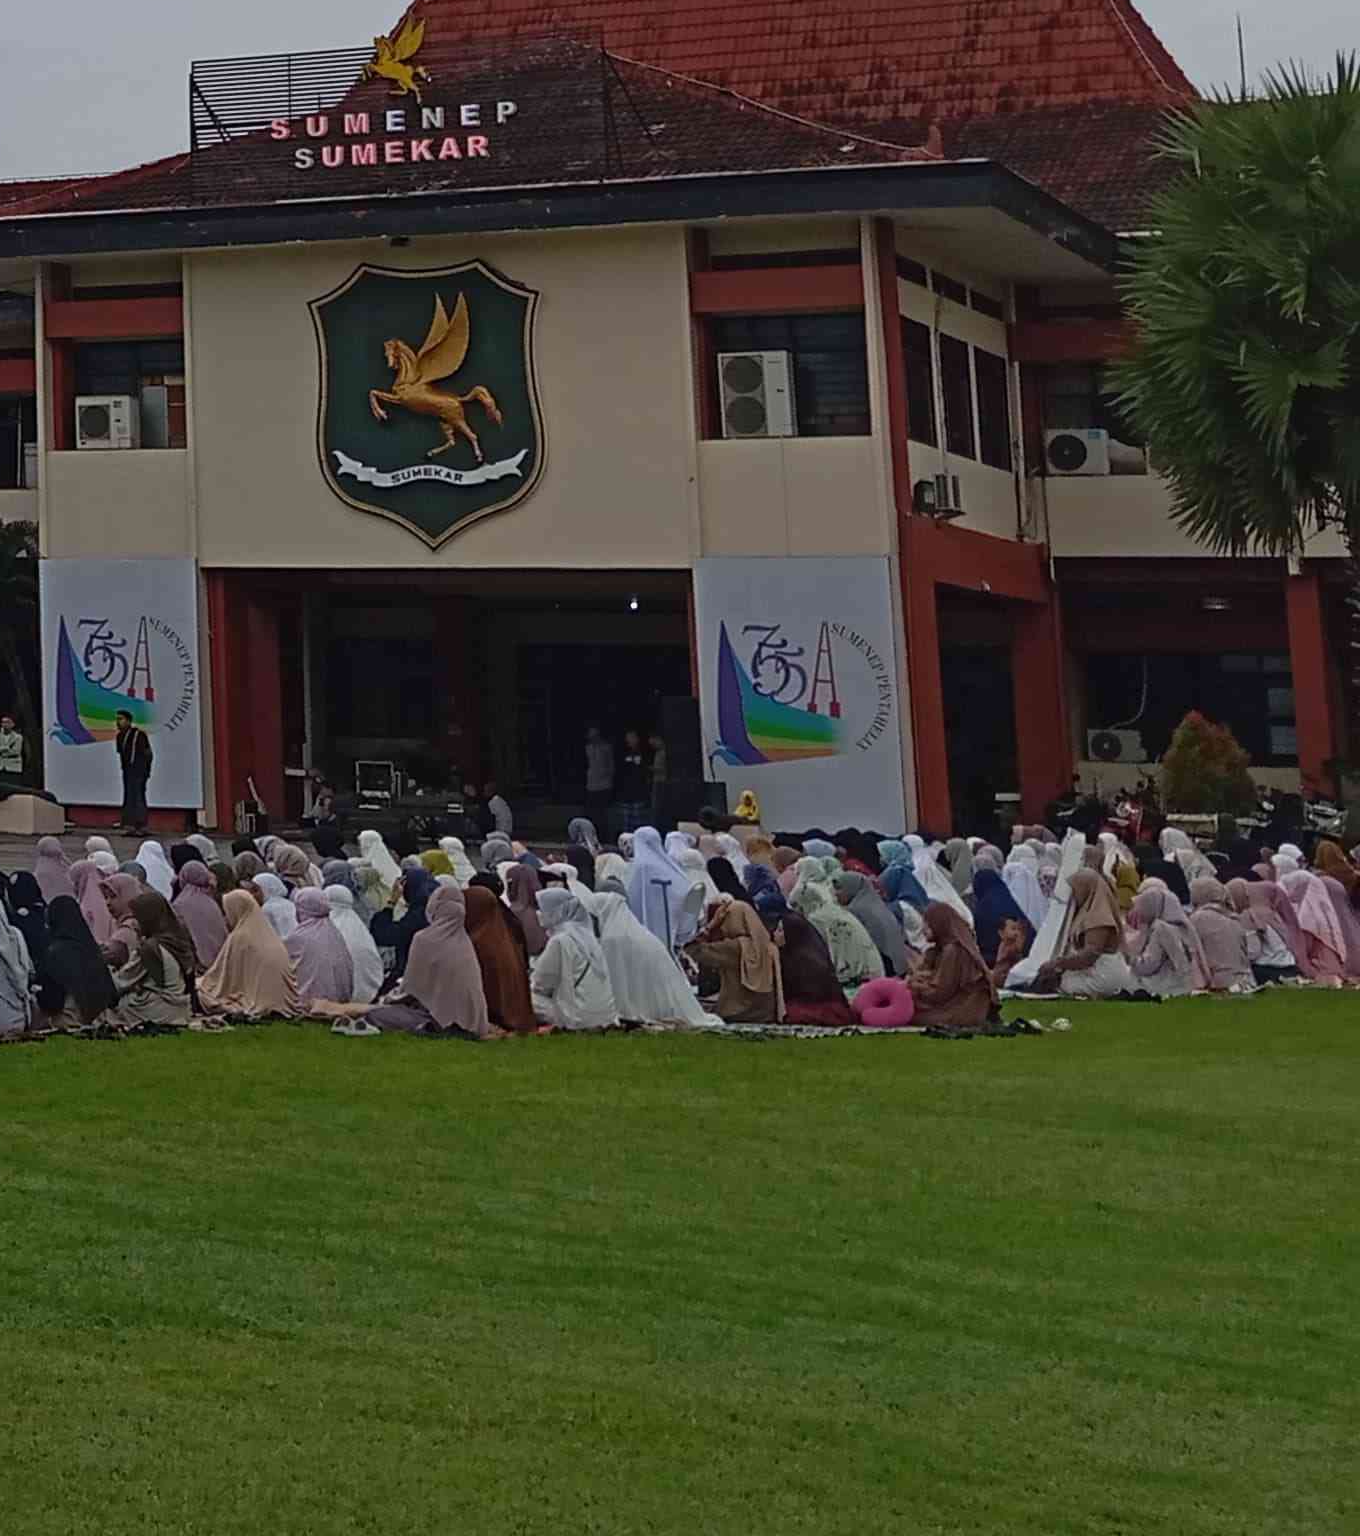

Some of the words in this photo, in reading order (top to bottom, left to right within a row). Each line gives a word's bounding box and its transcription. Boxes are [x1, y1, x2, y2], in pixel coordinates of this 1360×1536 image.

[270, 100, 519, 141] SUMENEP
[294, 135, 491, 169] SUMEKAR
[391, 466, 464, 484] SUMEKAR
